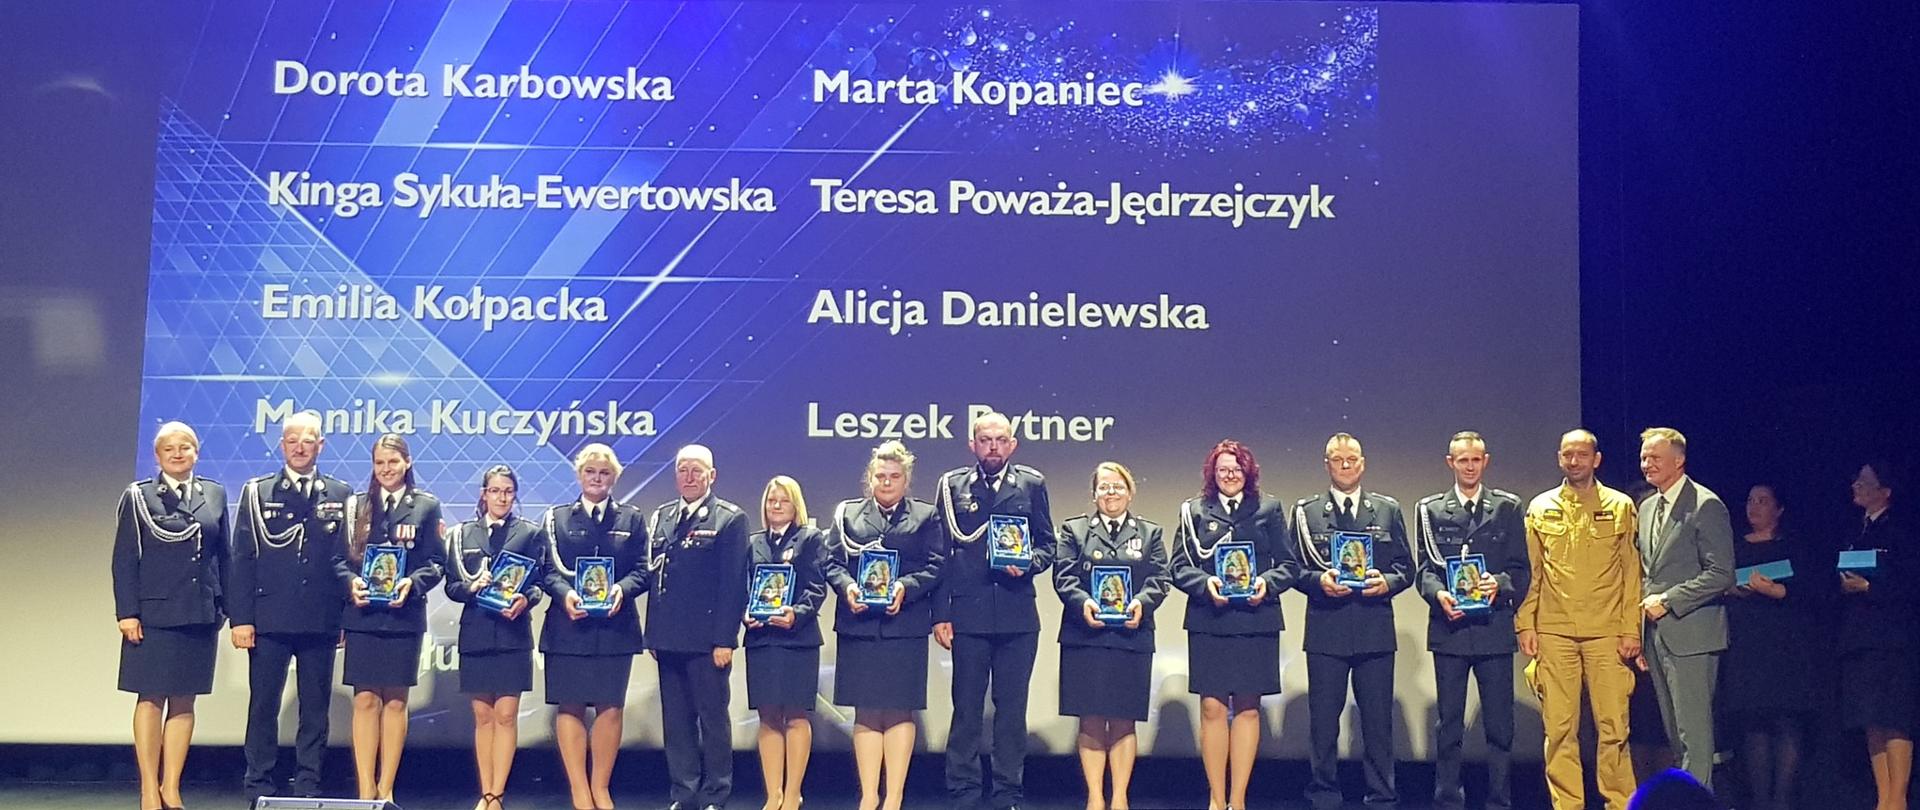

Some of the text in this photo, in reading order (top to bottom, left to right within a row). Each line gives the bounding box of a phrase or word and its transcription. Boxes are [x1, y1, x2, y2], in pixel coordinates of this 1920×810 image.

[273, 61, 675, 102] Dorota Karbowska
[812, 70, 1144, 116] Marta Kopaniec
[267, 172, 777, 218] Kinga Sykuła-Ewertowska
[810, 178, 1335, 229] Teresa Poważa-Jędrzejczyk
[262, 284, 609, 331] Emilia Kołpacka
[807, 289, 1210, 335] Alicja Danielewska
[255, 399, 657, 447] Mnika Kuczyńska
[807, 403, 953, 440] Leszek
